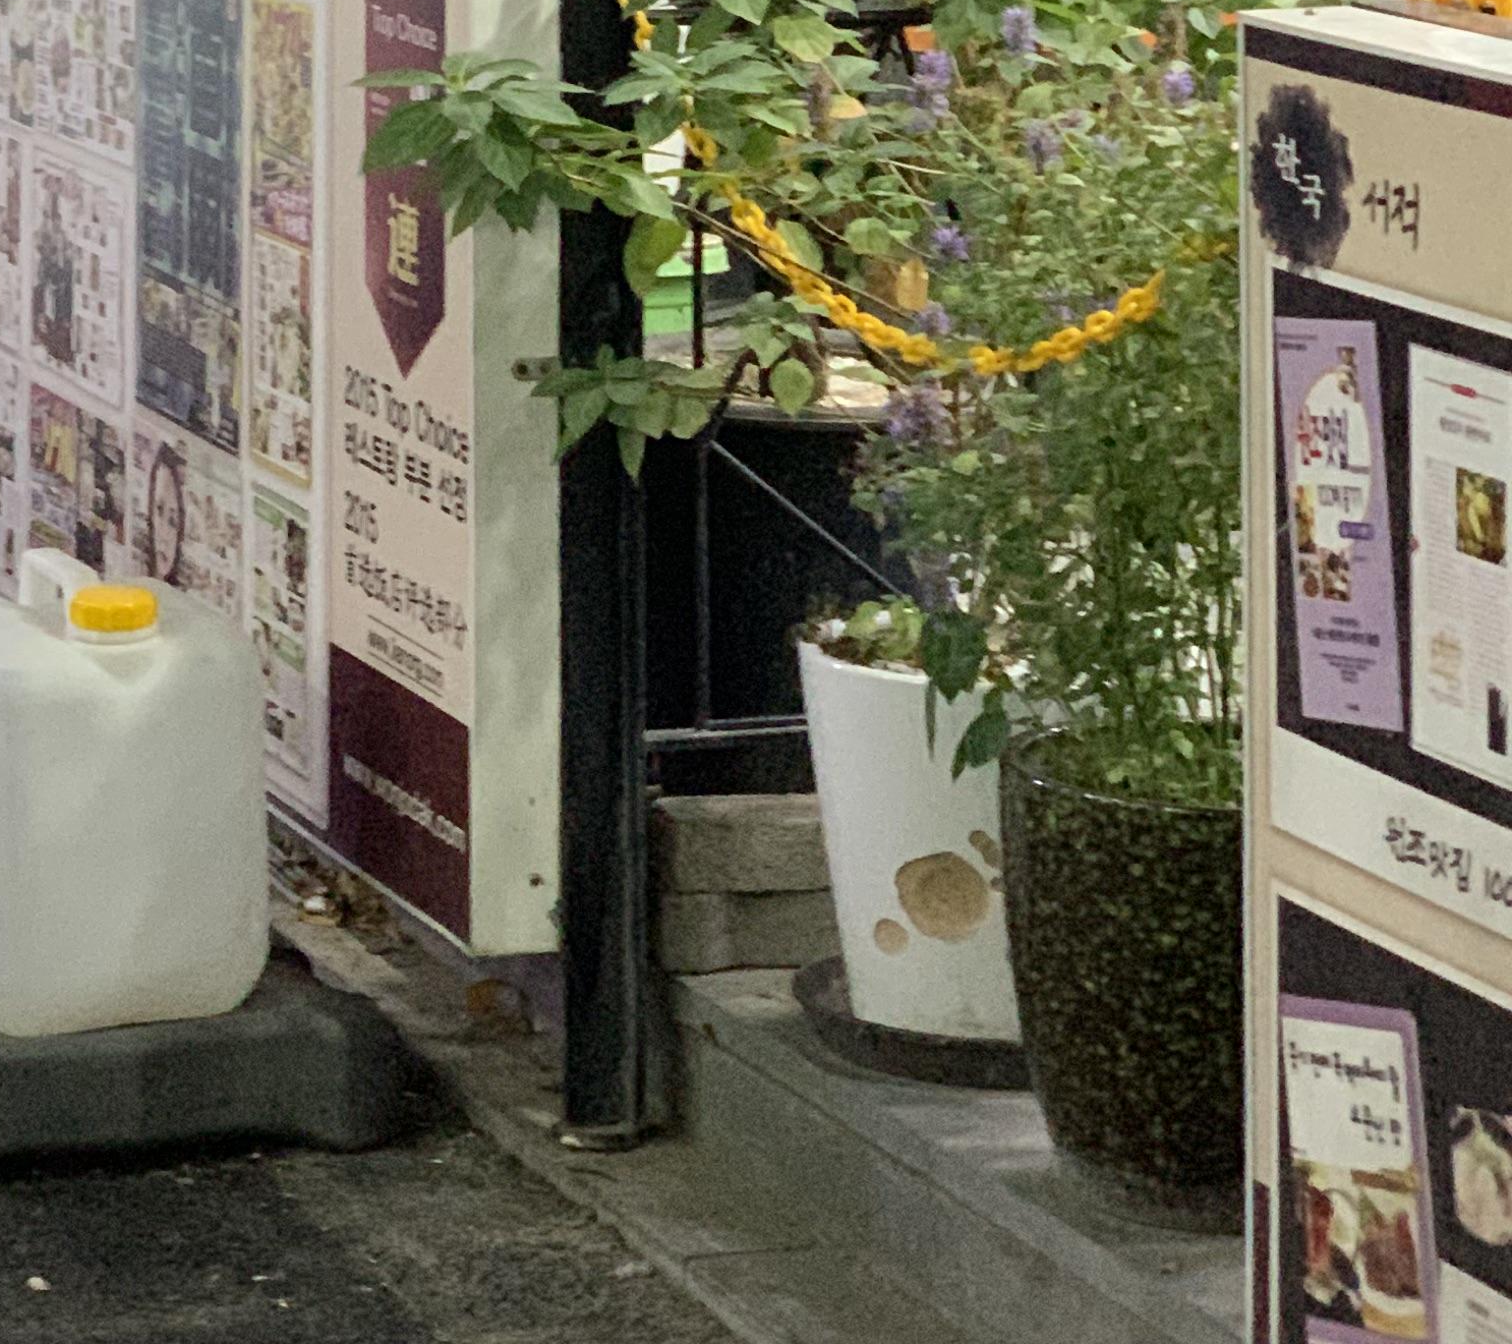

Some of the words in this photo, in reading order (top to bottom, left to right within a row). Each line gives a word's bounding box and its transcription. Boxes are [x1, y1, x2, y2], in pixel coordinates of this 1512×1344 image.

[1272, 133, 1326, 221] 한국
[344, 364, 379, 417] 2015
[381, 383, 411, 435] Top
[414, 399, 470, 464] Choice
